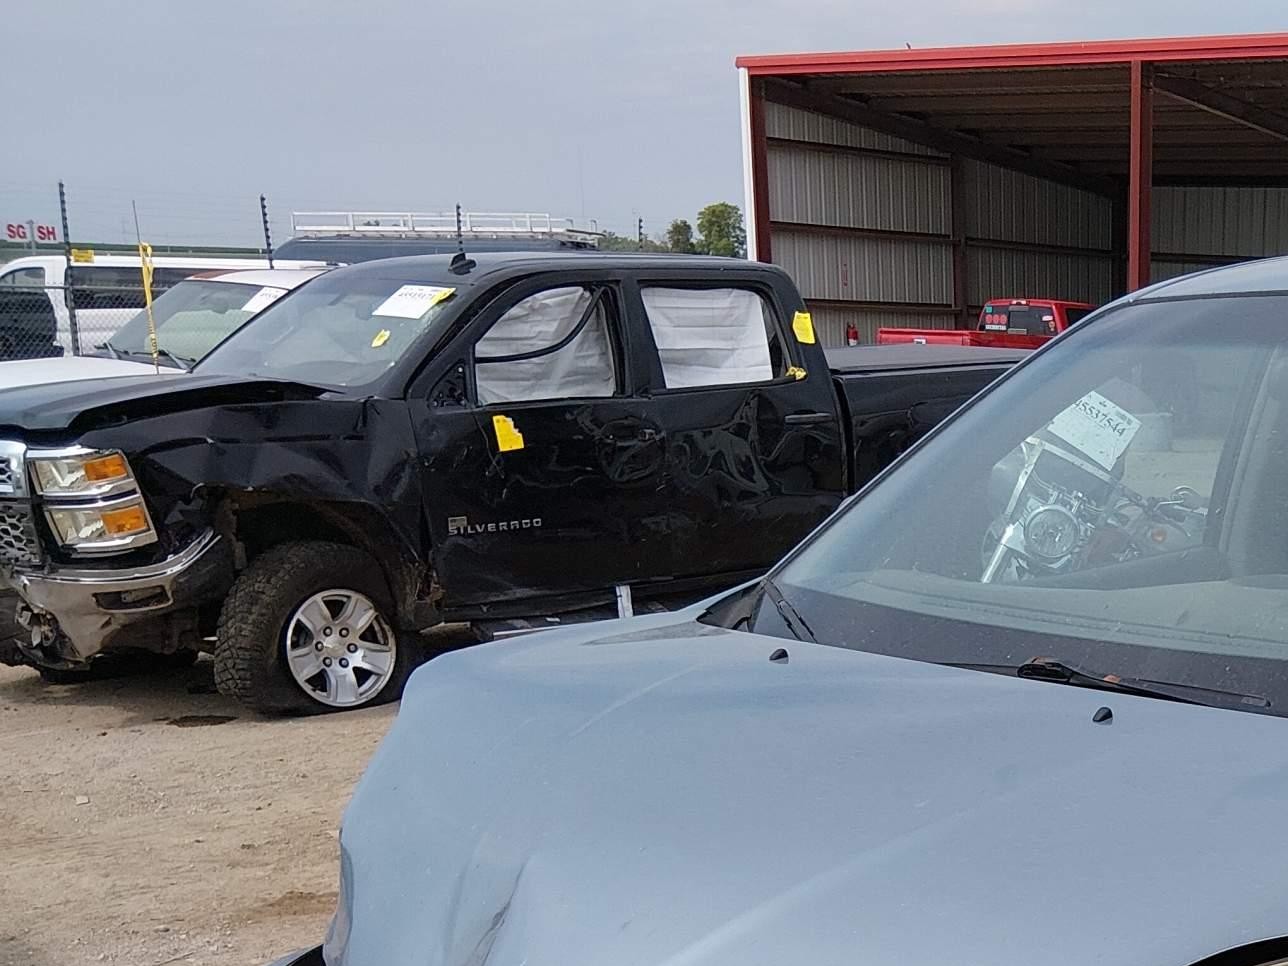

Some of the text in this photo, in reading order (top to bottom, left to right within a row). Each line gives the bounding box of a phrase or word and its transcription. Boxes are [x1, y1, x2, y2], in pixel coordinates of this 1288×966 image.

[7, 223, 27, 239] SG
[37, 225, 57, 241] SH
[448, 518, 542, 536] SILVERADO
